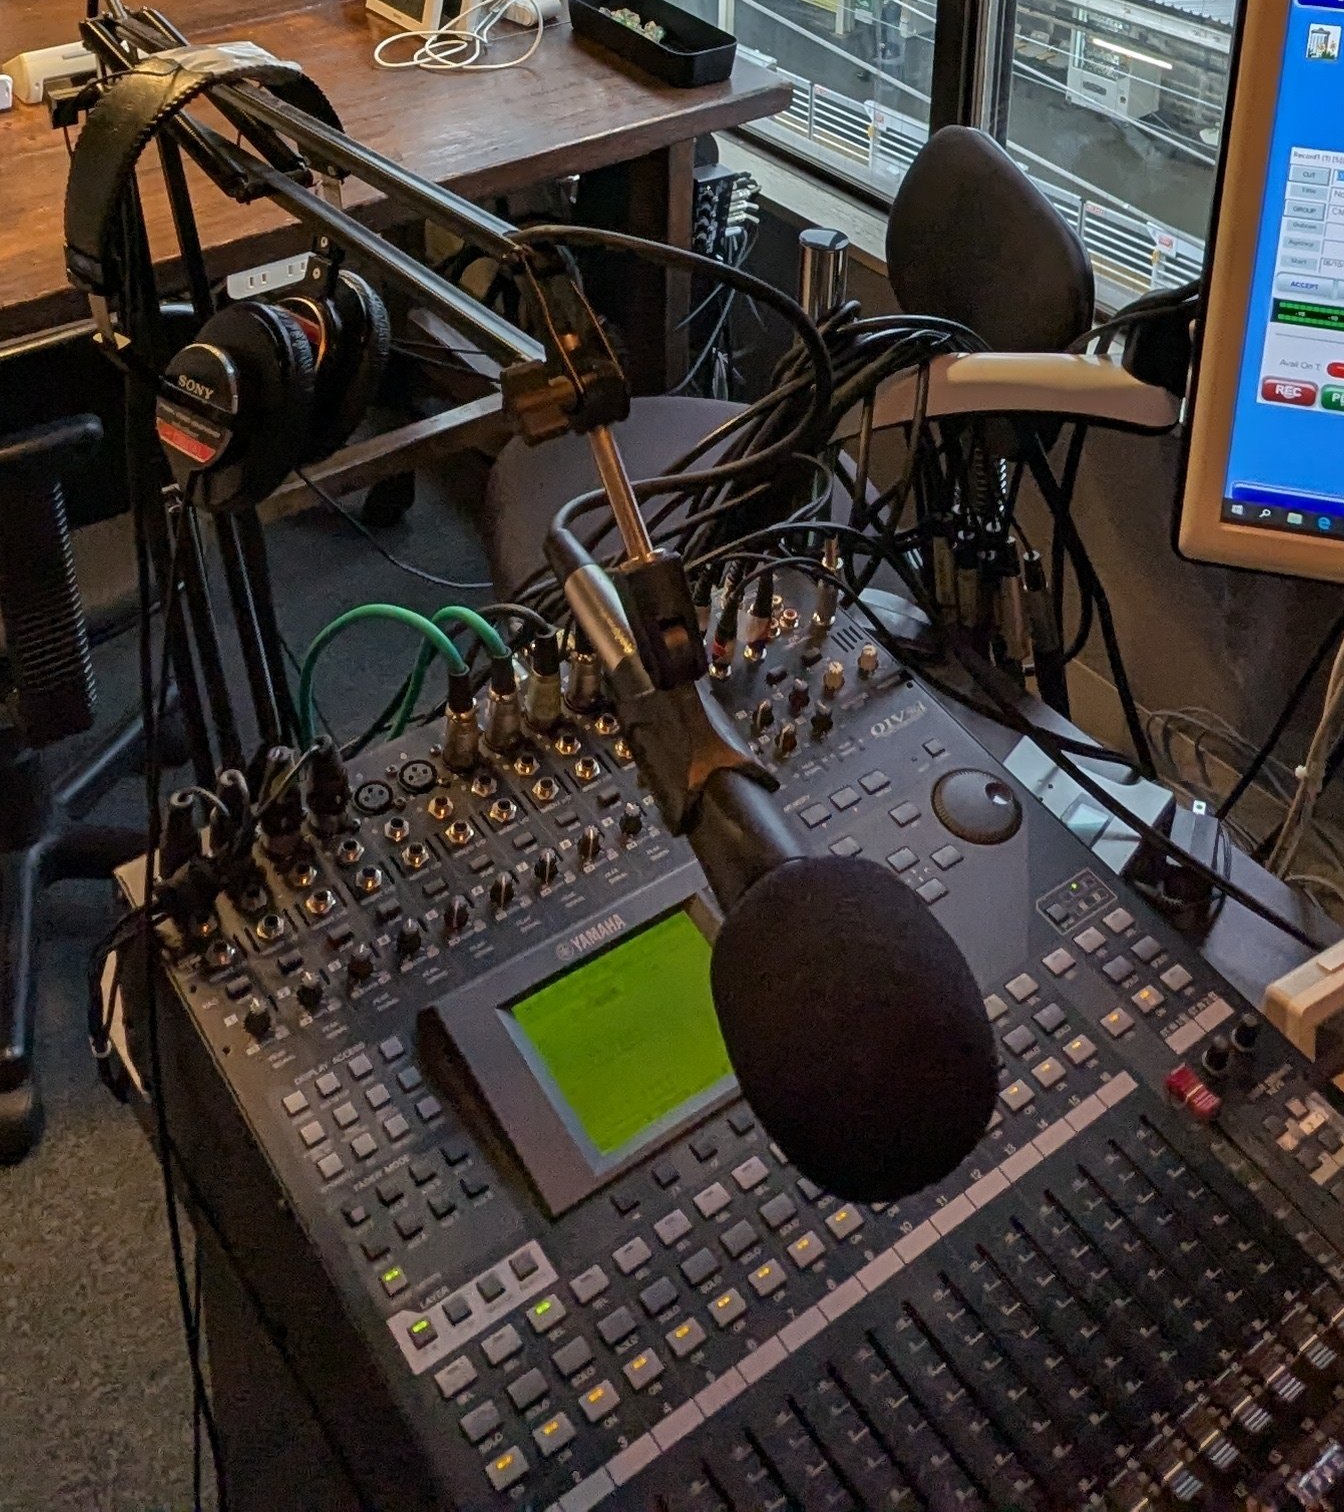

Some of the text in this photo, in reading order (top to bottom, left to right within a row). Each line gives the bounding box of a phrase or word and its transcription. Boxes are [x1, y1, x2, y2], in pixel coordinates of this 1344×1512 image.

[1302, 171, 1316, 179] CUT
[1293, 206, 1316, 215] GROUP
[176, 373, 216, 402] SONY
[1275, 384, 1302, 397] REC
[570, 913, 626, 953] YAMAHA
[384, 1155, 410, 1173] MODE
[970, 1168, 982, 1181] 12
[420, 1286, 450, 1309] LAYER
